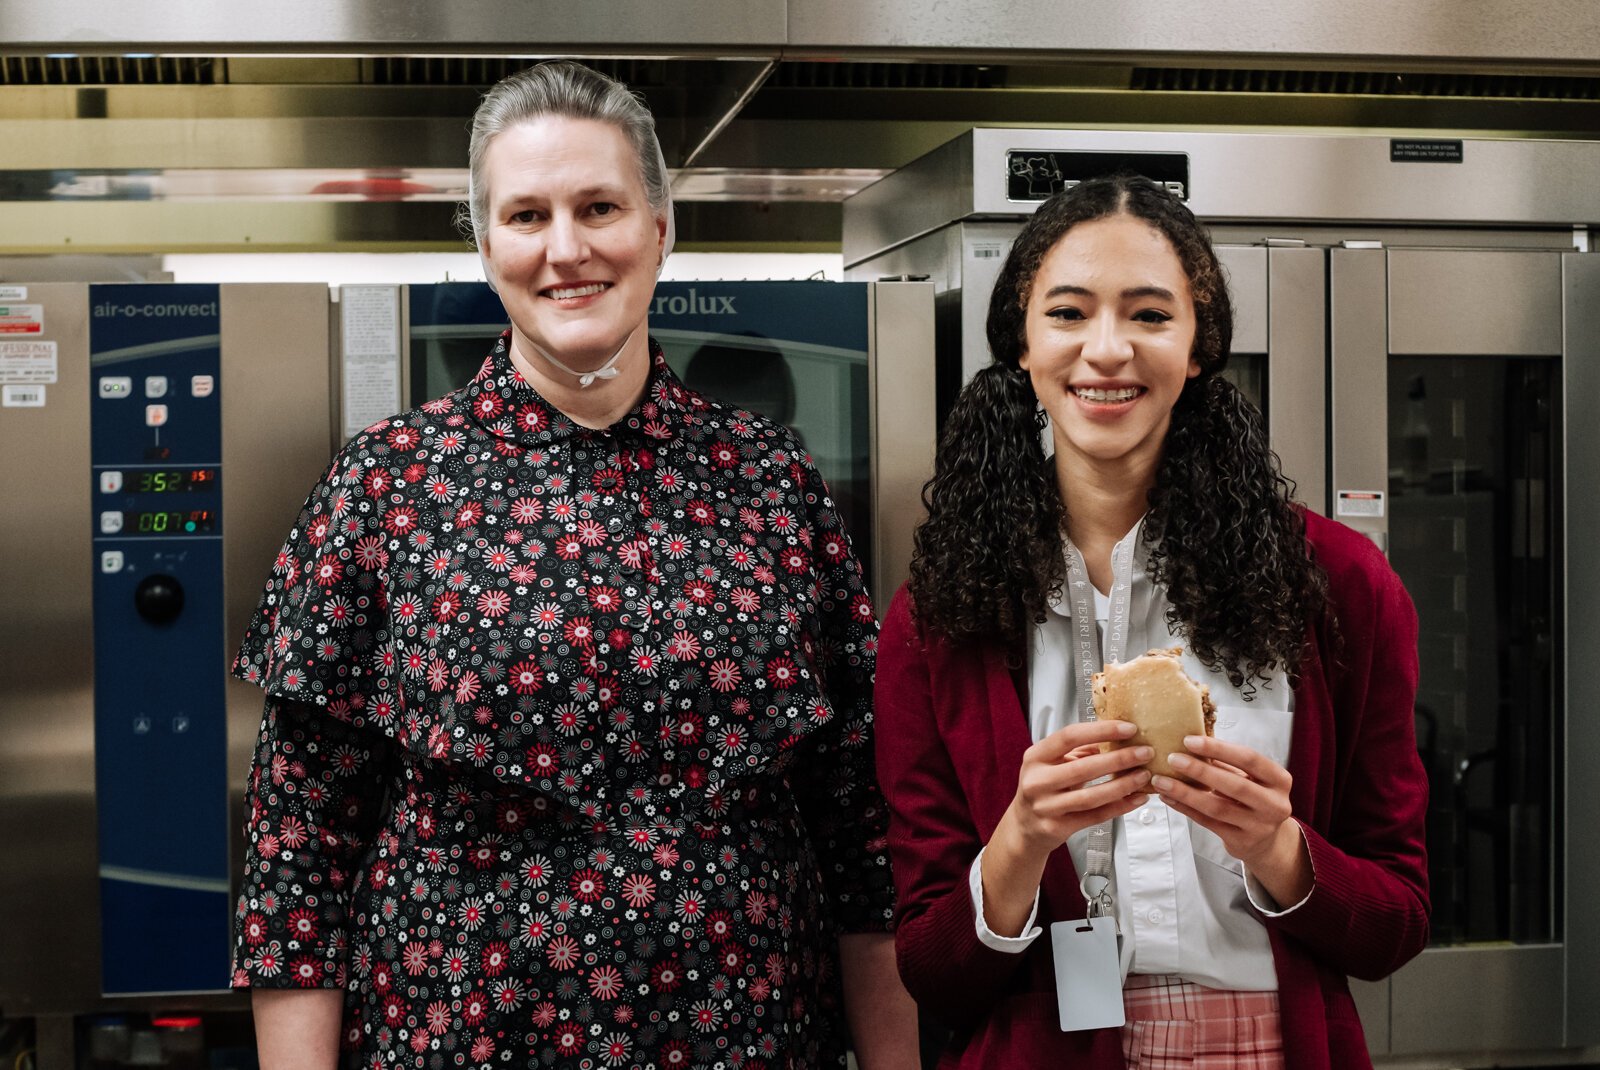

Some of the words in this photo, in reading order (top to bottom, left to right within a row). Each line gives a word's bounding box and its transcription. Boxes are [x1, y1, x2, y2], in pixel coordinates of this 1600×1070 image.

[94, 301, 217, 317] air-o-convect
[649, 288, 739, 315] rolux
[1077, 598, 1090, 637] TERRI
[1111, 596, 1125, 641] DANCE
